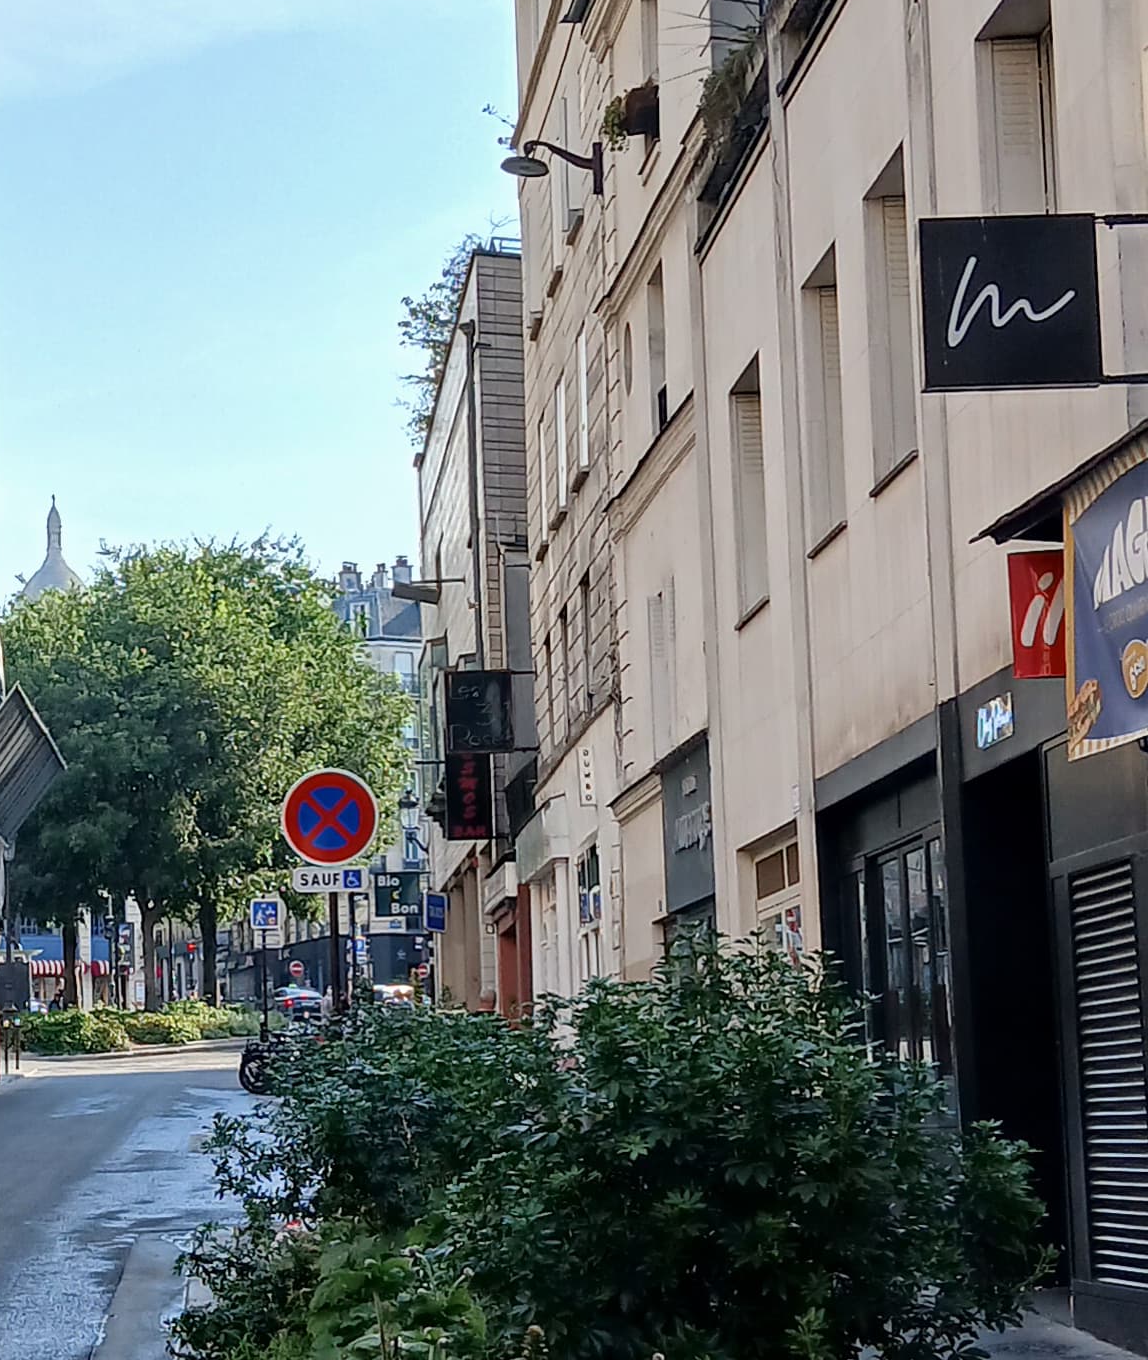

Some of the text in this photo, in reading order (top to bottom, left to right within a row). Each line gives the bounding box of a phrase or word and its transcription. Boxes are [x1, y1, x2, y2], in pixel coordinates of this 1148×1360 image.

[1094, 496, 1148, 611] MAG
[300, 872, 341, 886] SAUF
[377, 875, 401, 887] Bio
[390, 902, 419, 915] Bon
